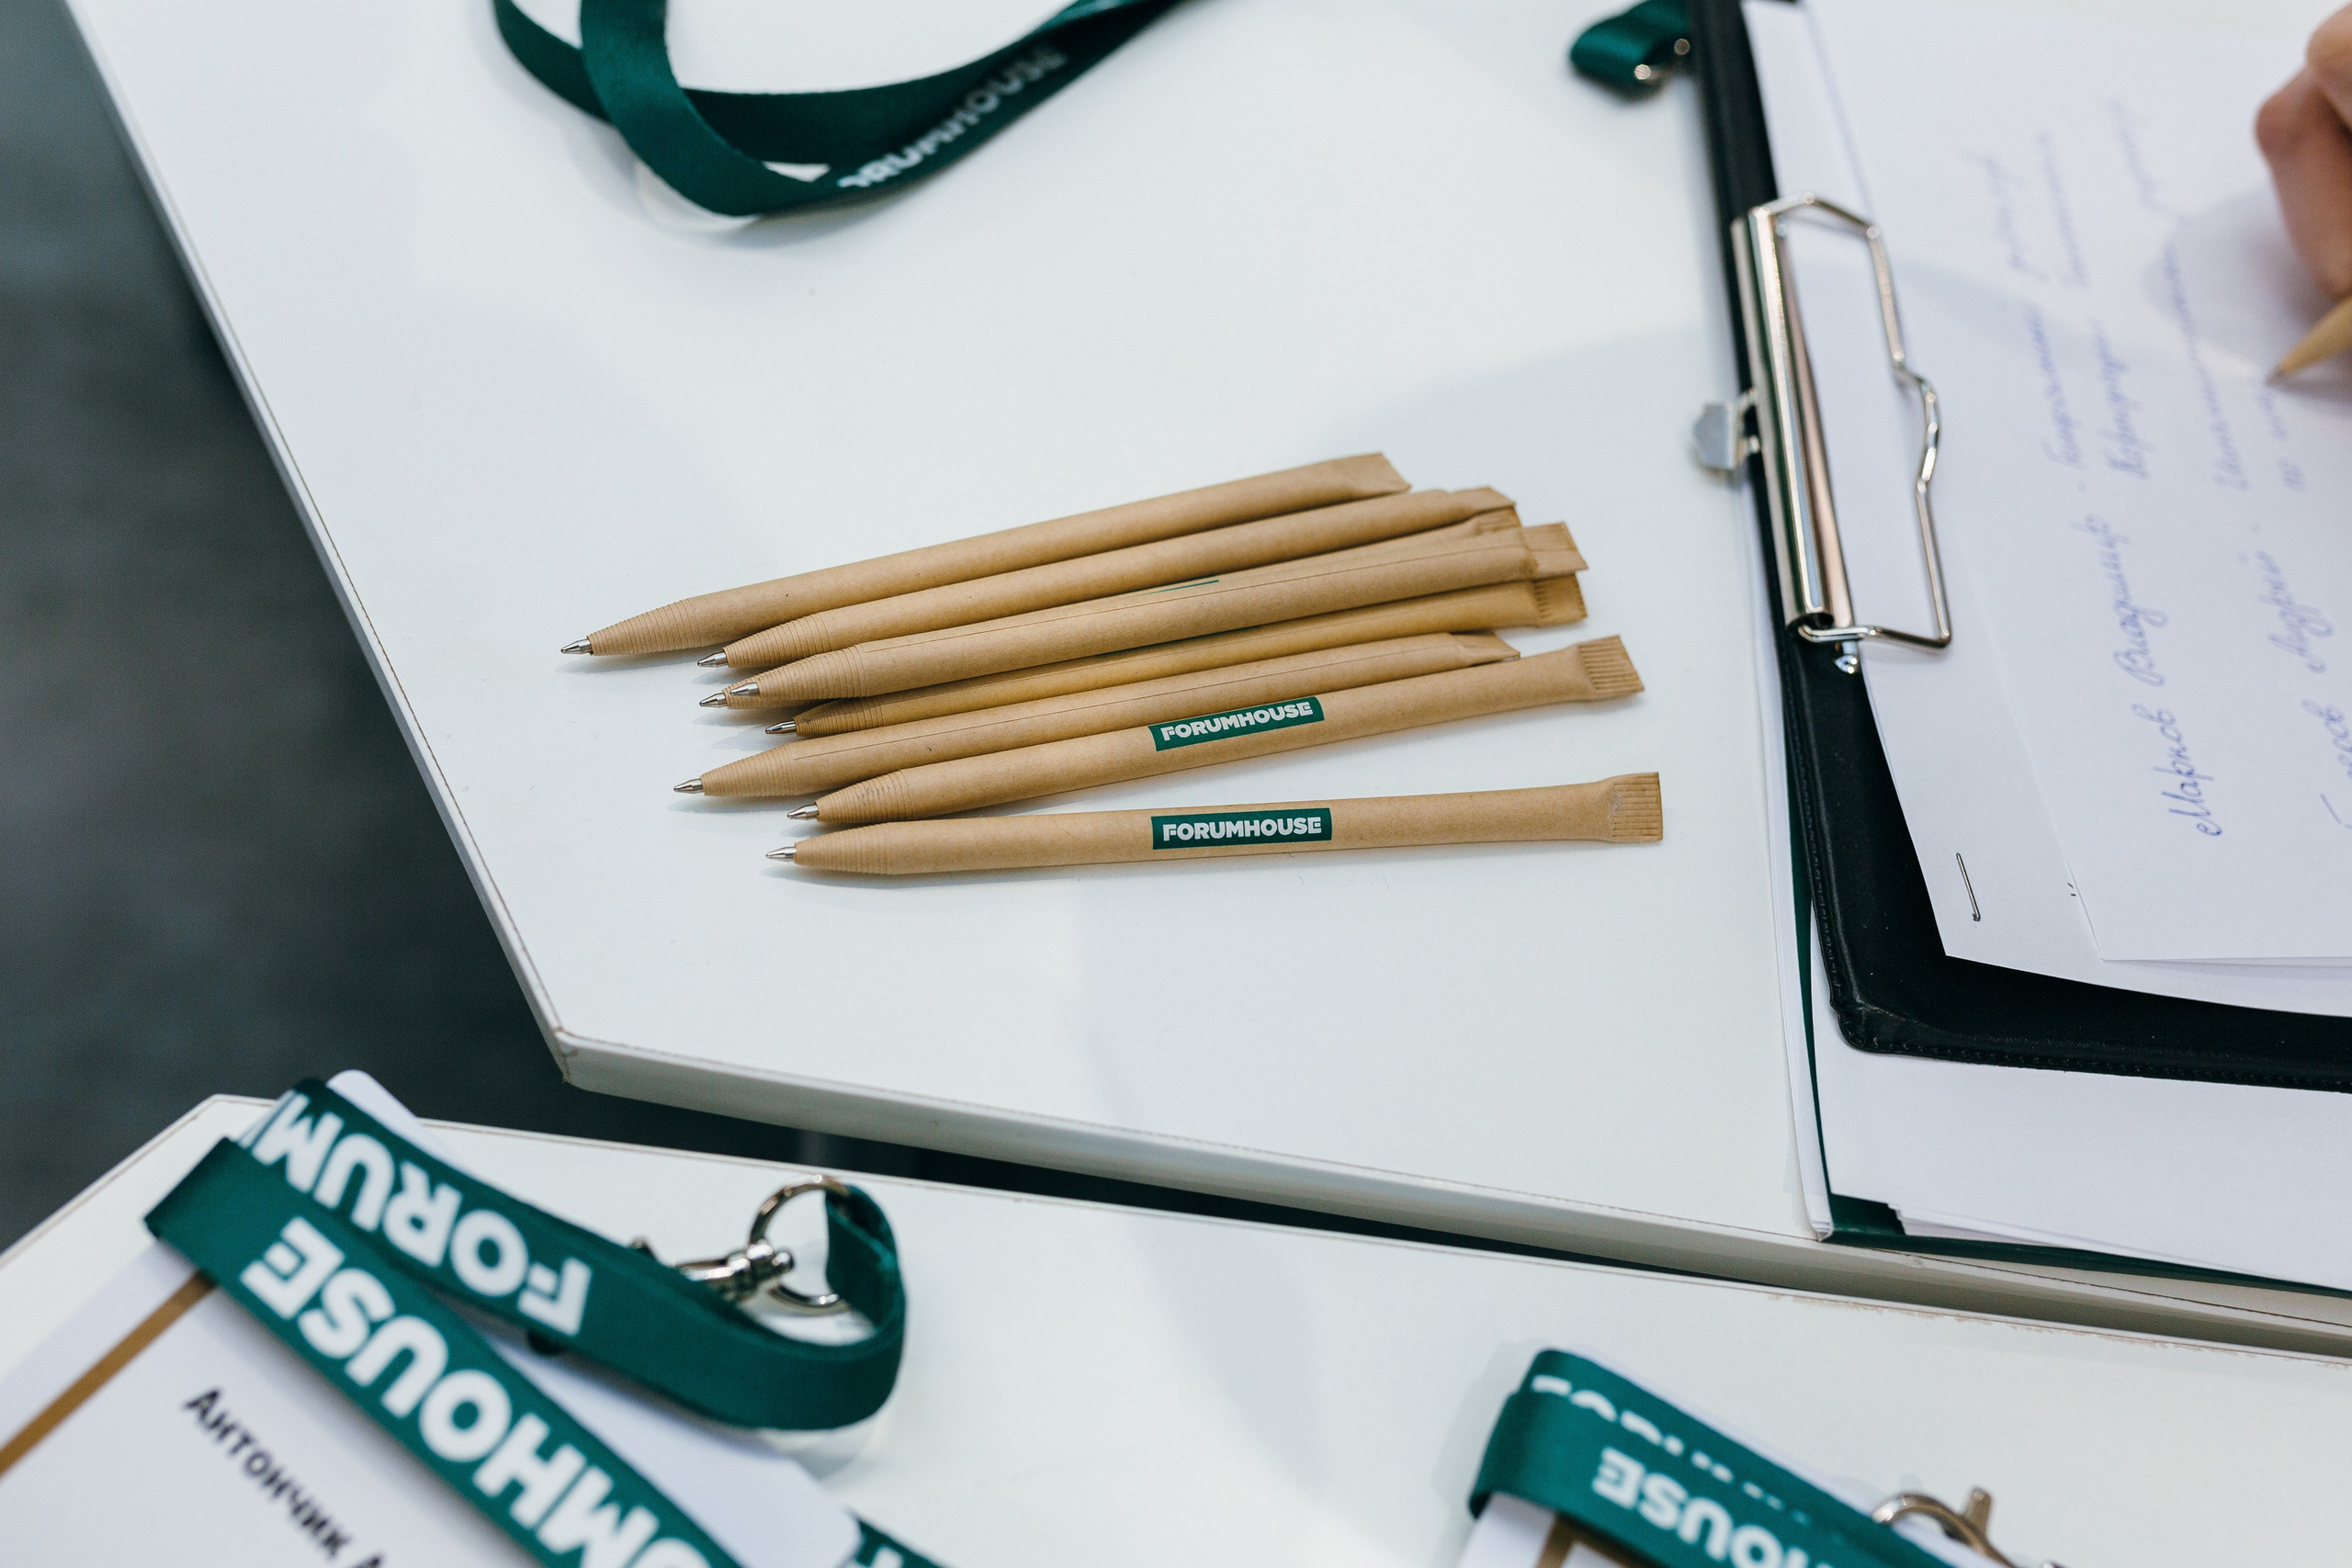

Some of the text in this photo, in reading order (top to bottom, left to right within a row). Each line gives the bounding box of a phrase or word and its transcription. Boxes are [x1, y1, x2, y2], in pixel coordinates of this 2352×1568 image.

[1160, 701, 1313, 741] FORUMHOUSE
[1162, 817, 1322, 841] FORUMHOUSE
[1592, 1446, 1836, 1568] OUSE
